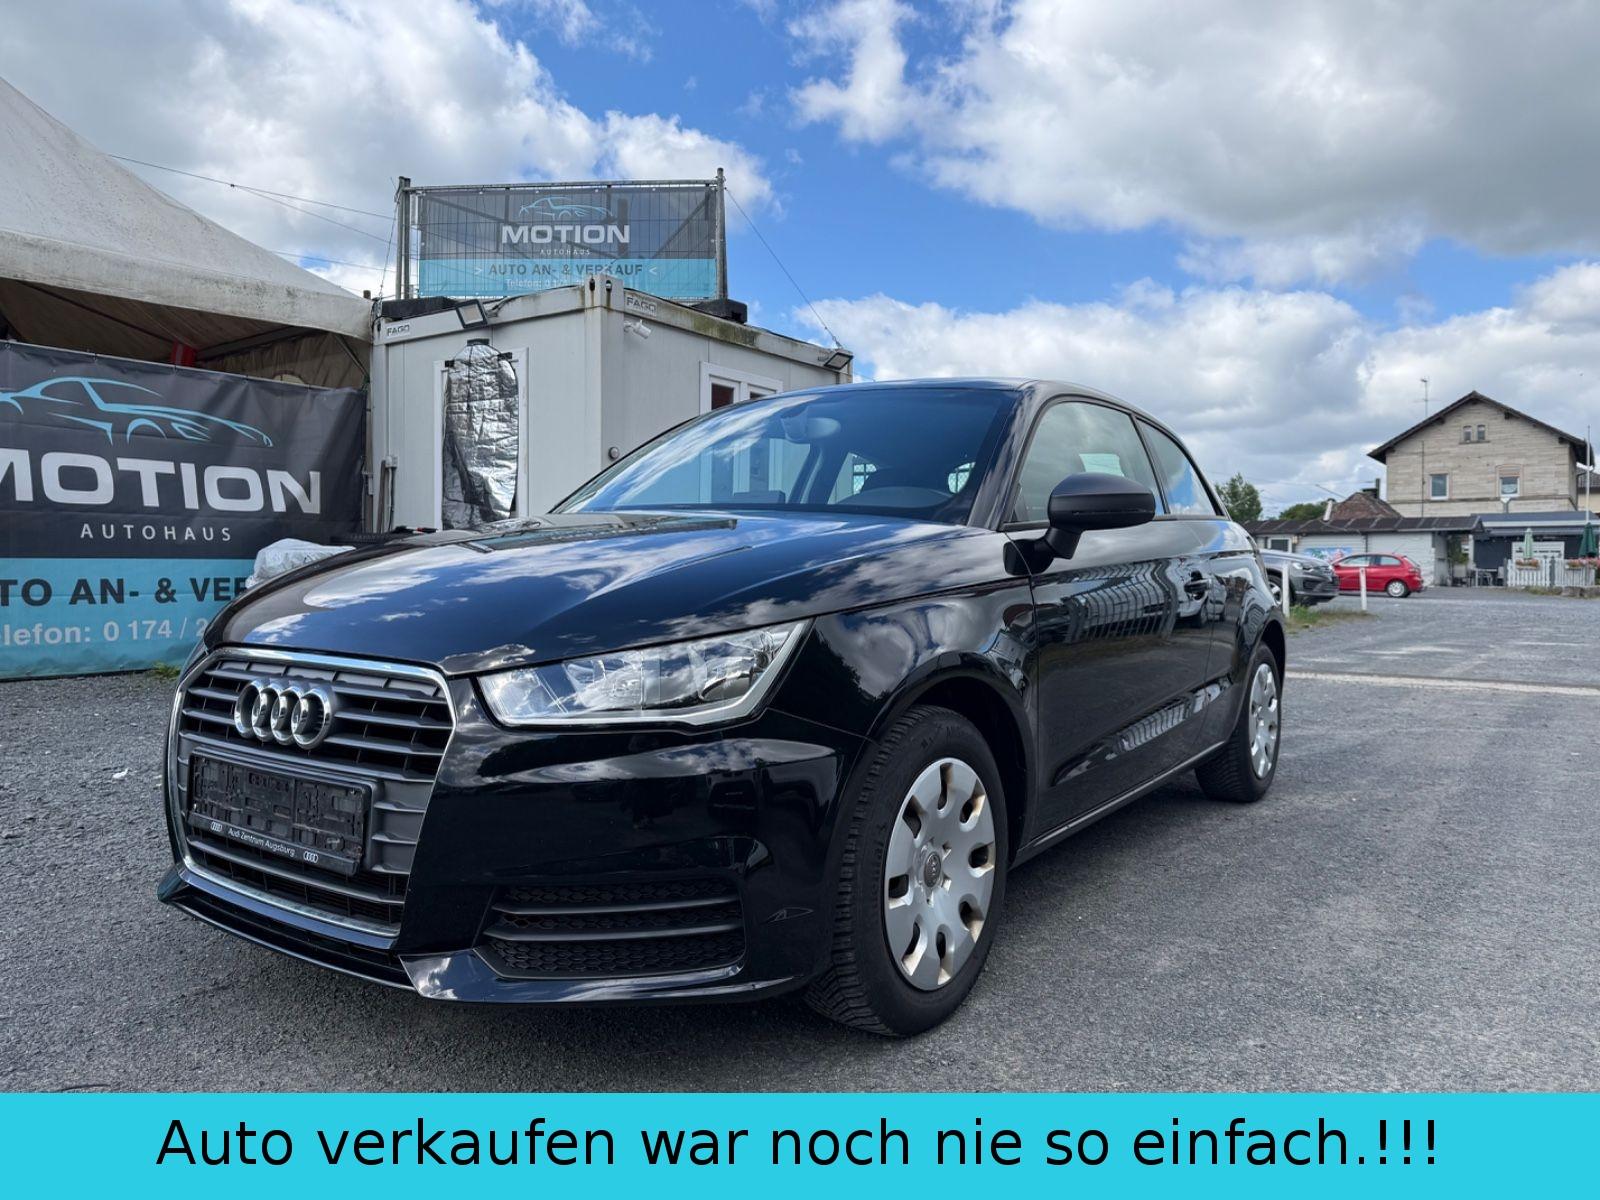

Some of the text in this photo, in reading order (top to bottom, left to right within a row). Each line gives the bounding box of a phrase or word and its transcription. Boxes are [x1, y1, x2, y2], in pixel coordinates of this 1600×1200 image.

[501, 224, 630, 244] MOTION
[488, 264, 643, 276] AUTO AN- & VERKAUF
[80, 523, 231, 541] AUTOHAUS
[68, 578, 139, 605] AN-
[154, 577, 178, 604] &
[0, 623, 91, 646] lefon:
[103, 621, 120, 642] 0
[127, 619, 172, 640] 174
[228, 828, 296, 858] Audi Zentrum Augsburg
